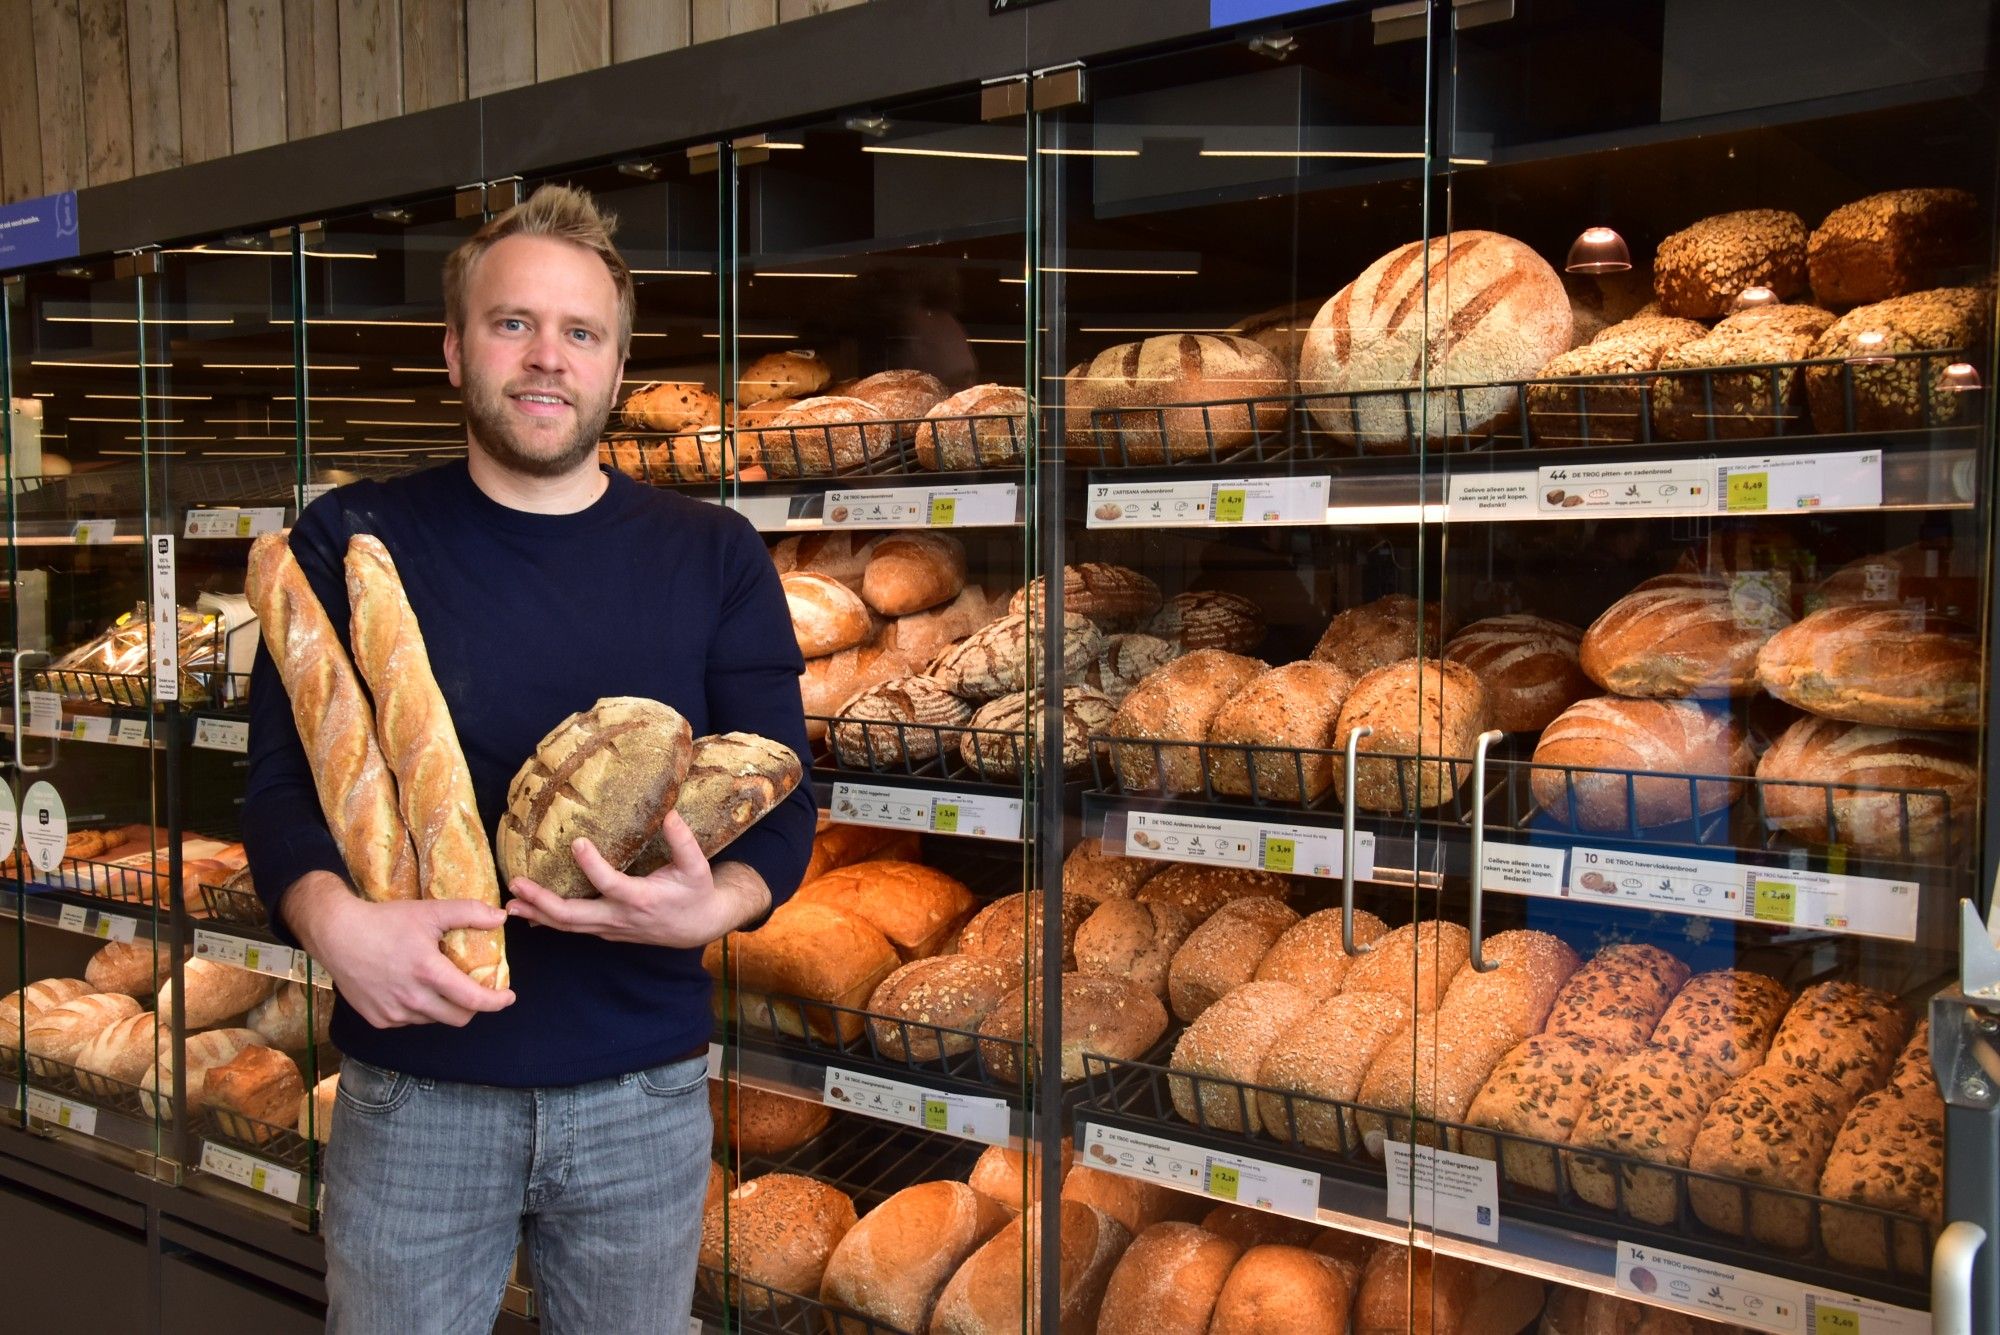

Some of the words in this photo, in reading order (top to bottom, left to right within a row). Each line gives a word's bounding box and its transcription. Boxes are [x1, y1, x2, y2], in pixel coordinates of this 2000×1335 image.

[1550, 470, 1566, 480] 44
[1634, 468, 1672, 476] zadenbrood
[1097, 488, 1108, 496] 37
[840, 786, 848, 794] 29
[1139, 816, 1146, 824] 11
[1585, 853, 1598, 864] 10
[1634, 861, 1697, 873] havervlokkenbrood
[1504, 875, 1531, 883] Bedankt!
[835, 1072, 840, 1080] 9
[1097, 1129, 1102, 1137] 5
[1442, 1160, 1479, 1172] allergenen?
[1631, 1248, 1645, 1261] 14
[1652, 1256, 1661, 1264] DE
[1664, 1258, 1682, 1268] TROG
